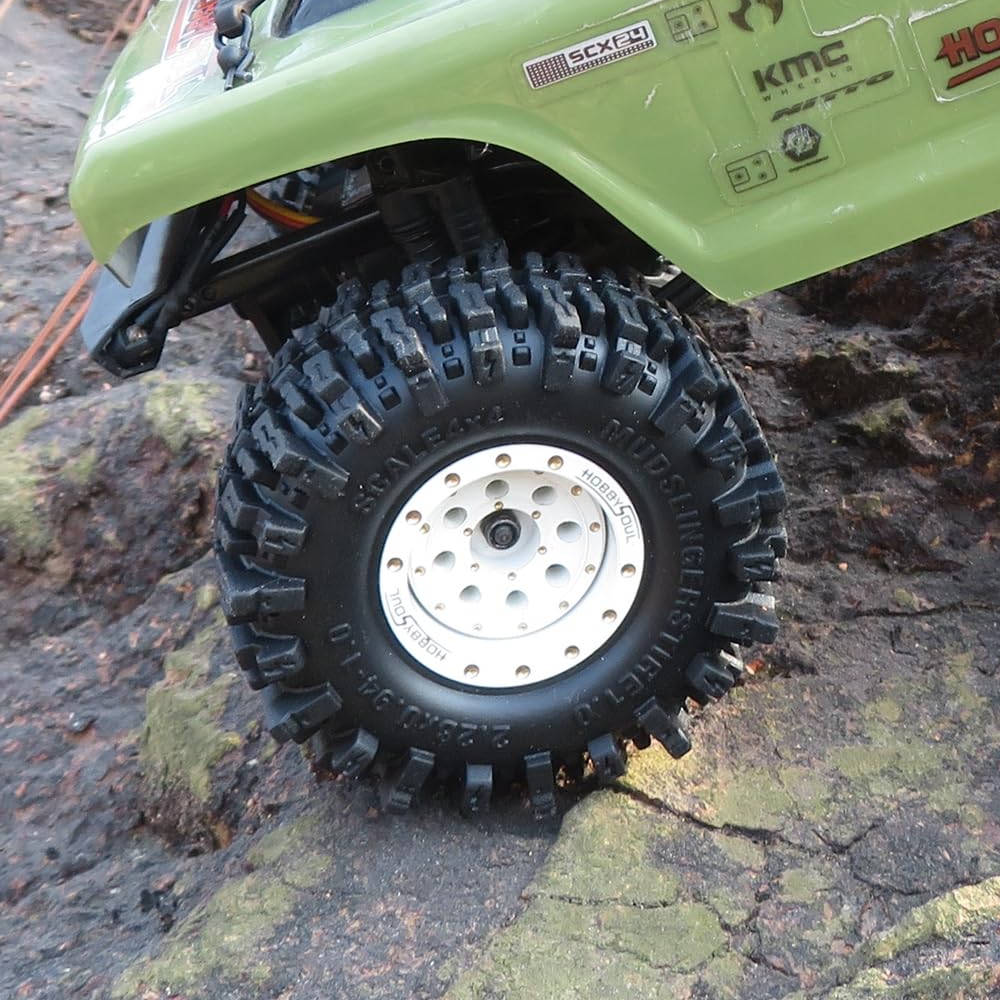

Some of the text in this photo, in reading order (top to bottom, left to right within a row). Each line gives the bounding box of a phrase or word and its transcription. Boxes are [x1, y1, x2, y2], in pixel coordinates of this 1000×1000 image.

[568, 24, 650, 65] SCX24
[752, 39, 850, 93] KMC
[578, 468, 641, 544] HOBBYSOUL
[384, 586, 453, 663] HOBBYSOUL
